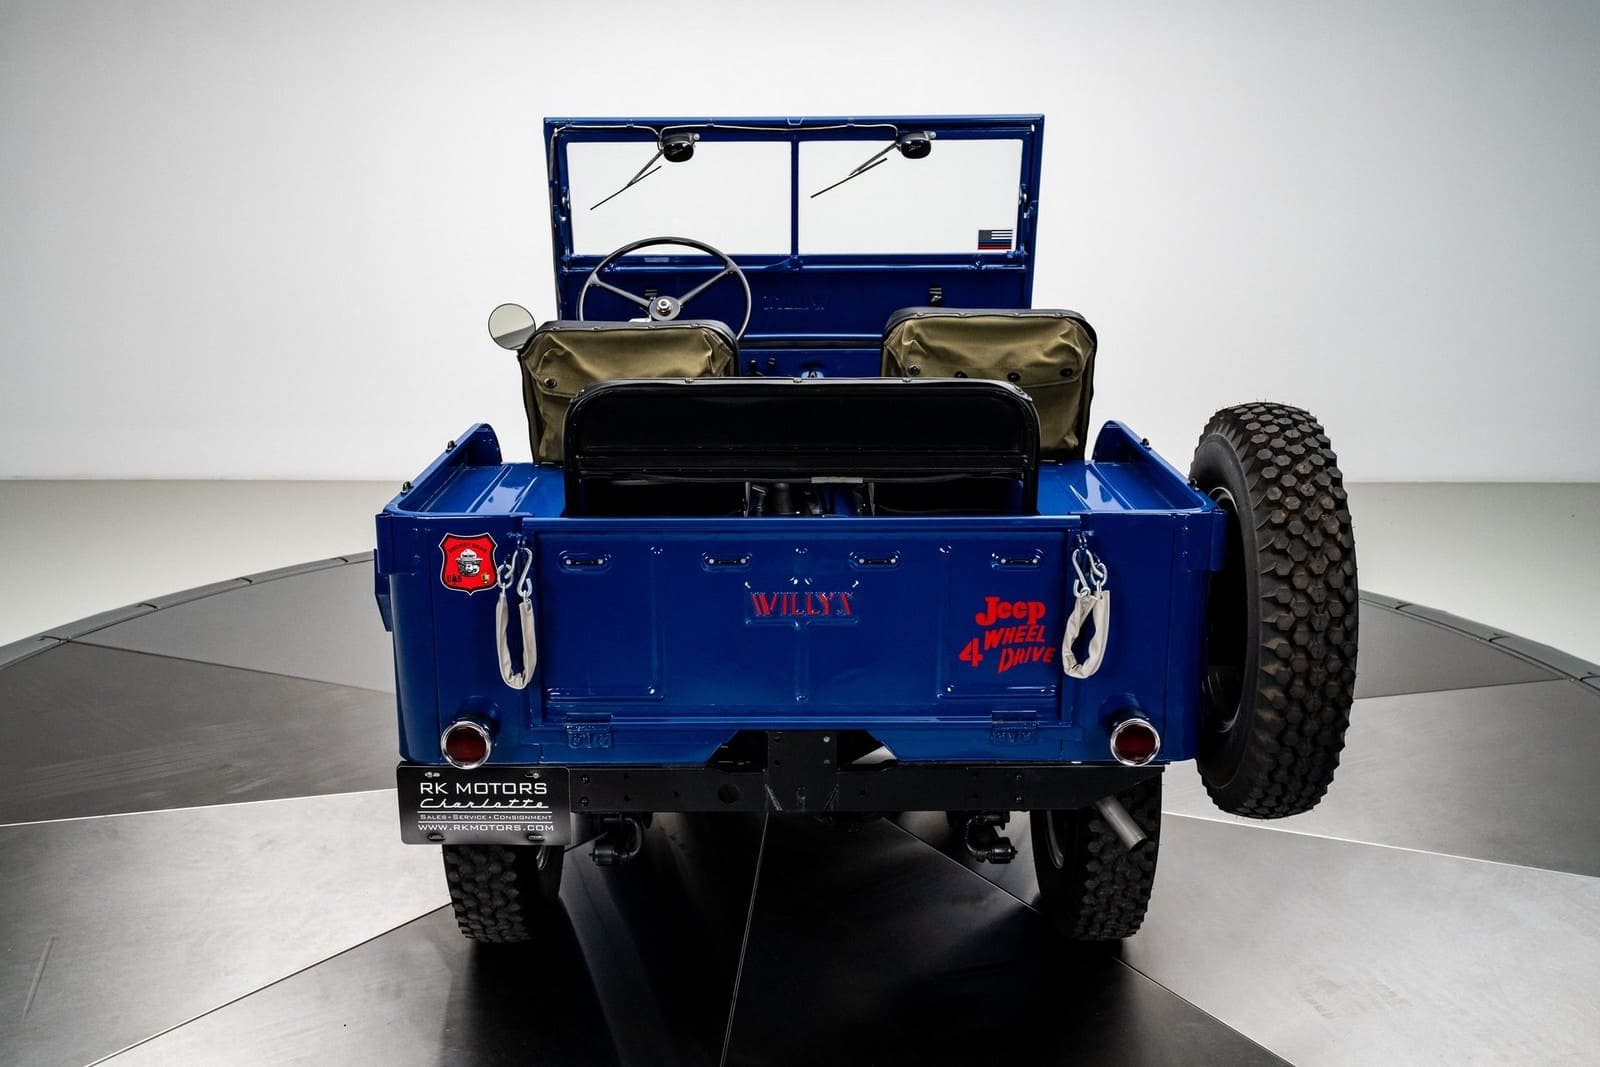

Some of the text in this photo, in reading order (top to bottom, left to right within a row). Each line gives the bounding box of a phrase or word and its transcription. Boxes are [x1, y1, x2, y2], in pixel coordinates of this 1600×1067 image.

[975, 596, 1046, 626] Jeep
[959, 624, 1046, 667] 4 WHEEL
[997, 646, 1056, 674] DRIVE
[420, 782, 548, 795] RK MOTORS
[419, 798, 550, 809] Charlotte
[417, 823, 554, 832] WWW.RKMOTORS.COM
